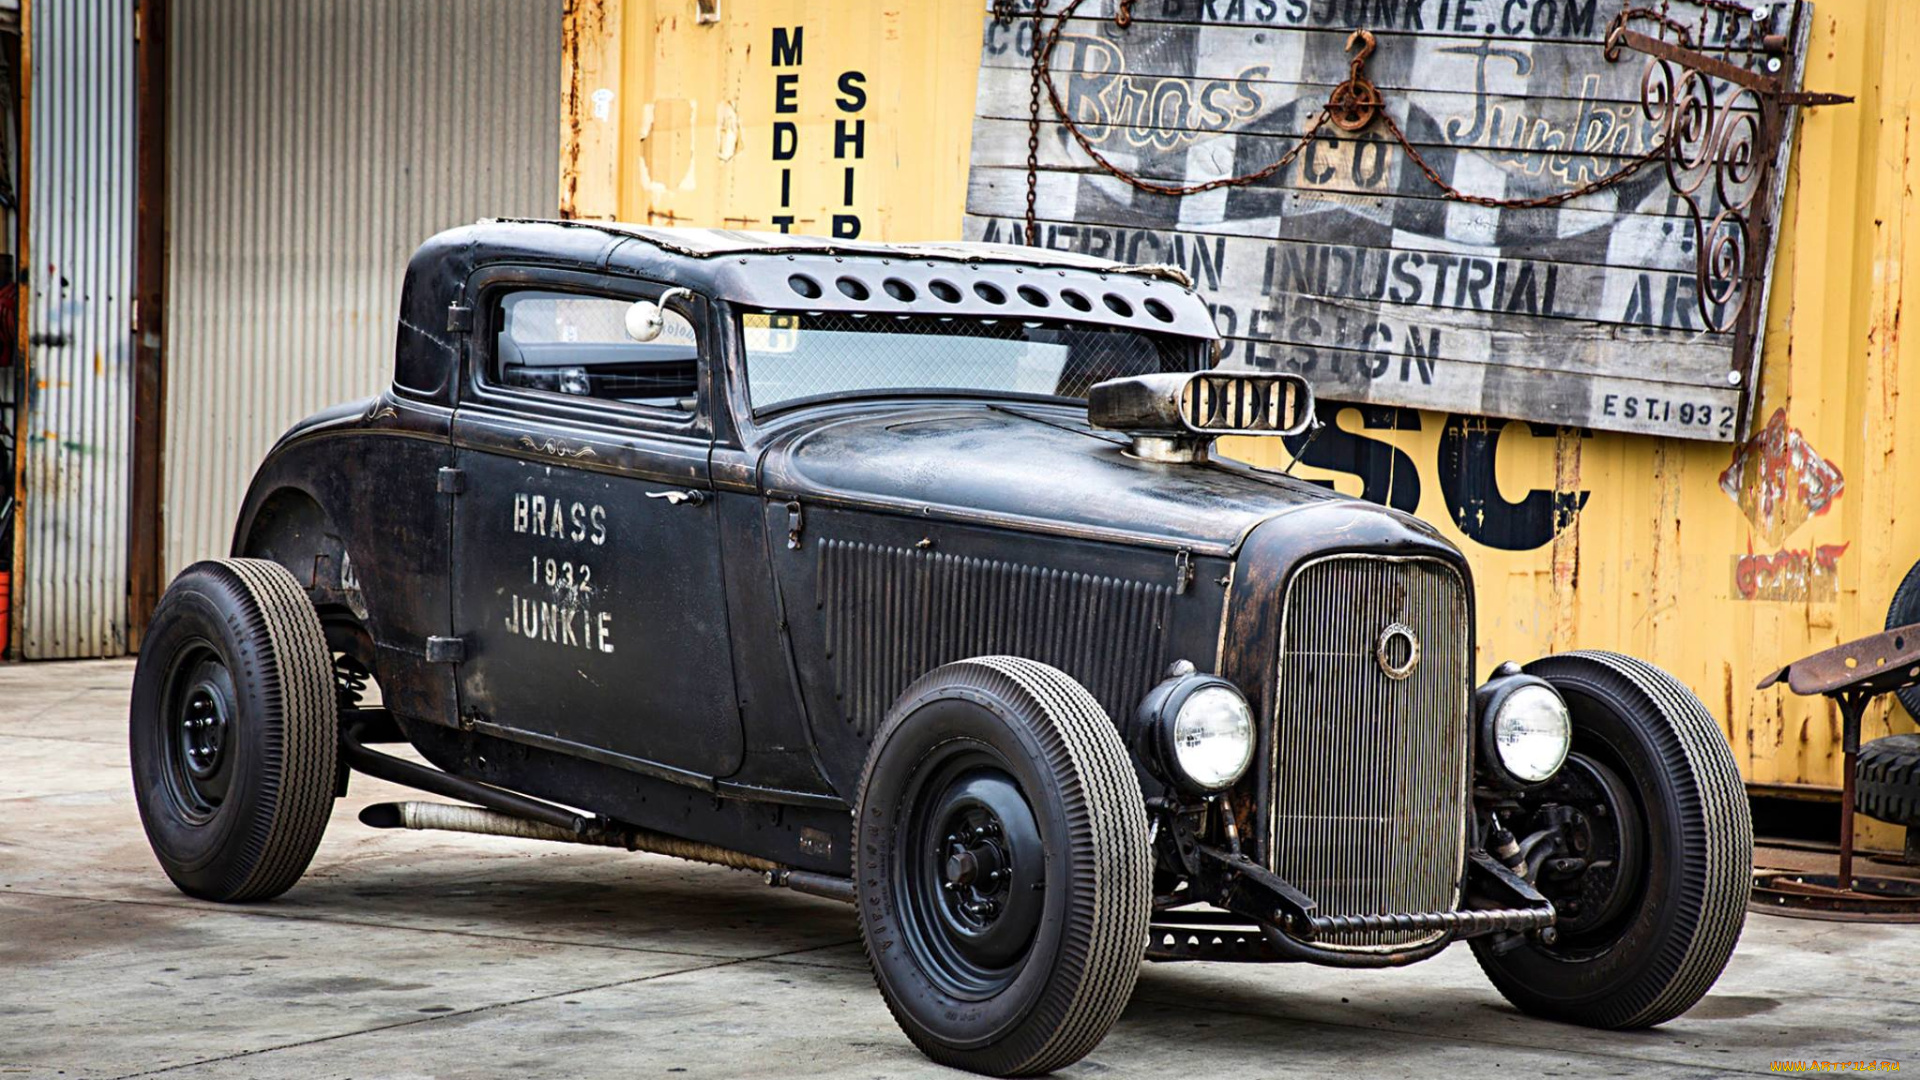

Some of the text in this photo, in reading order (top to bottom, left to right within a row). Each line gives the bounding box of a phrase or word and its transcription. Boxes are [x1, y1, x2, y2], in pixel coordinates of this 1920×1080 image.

[1046, 32, 1271, 151] Brass
[1303, 128, 1390, 188] CO
[1261, 244, 1577, 319] INDUSTRIAL
[1621, 273, 1742, 340] ART
[1207, 303, 1442, 386] DESIGN
[513, 493, 607, 546] BRASS
[532, 556, 593, 593] 1932
[505, 594, 616, 654] JUNKIE
